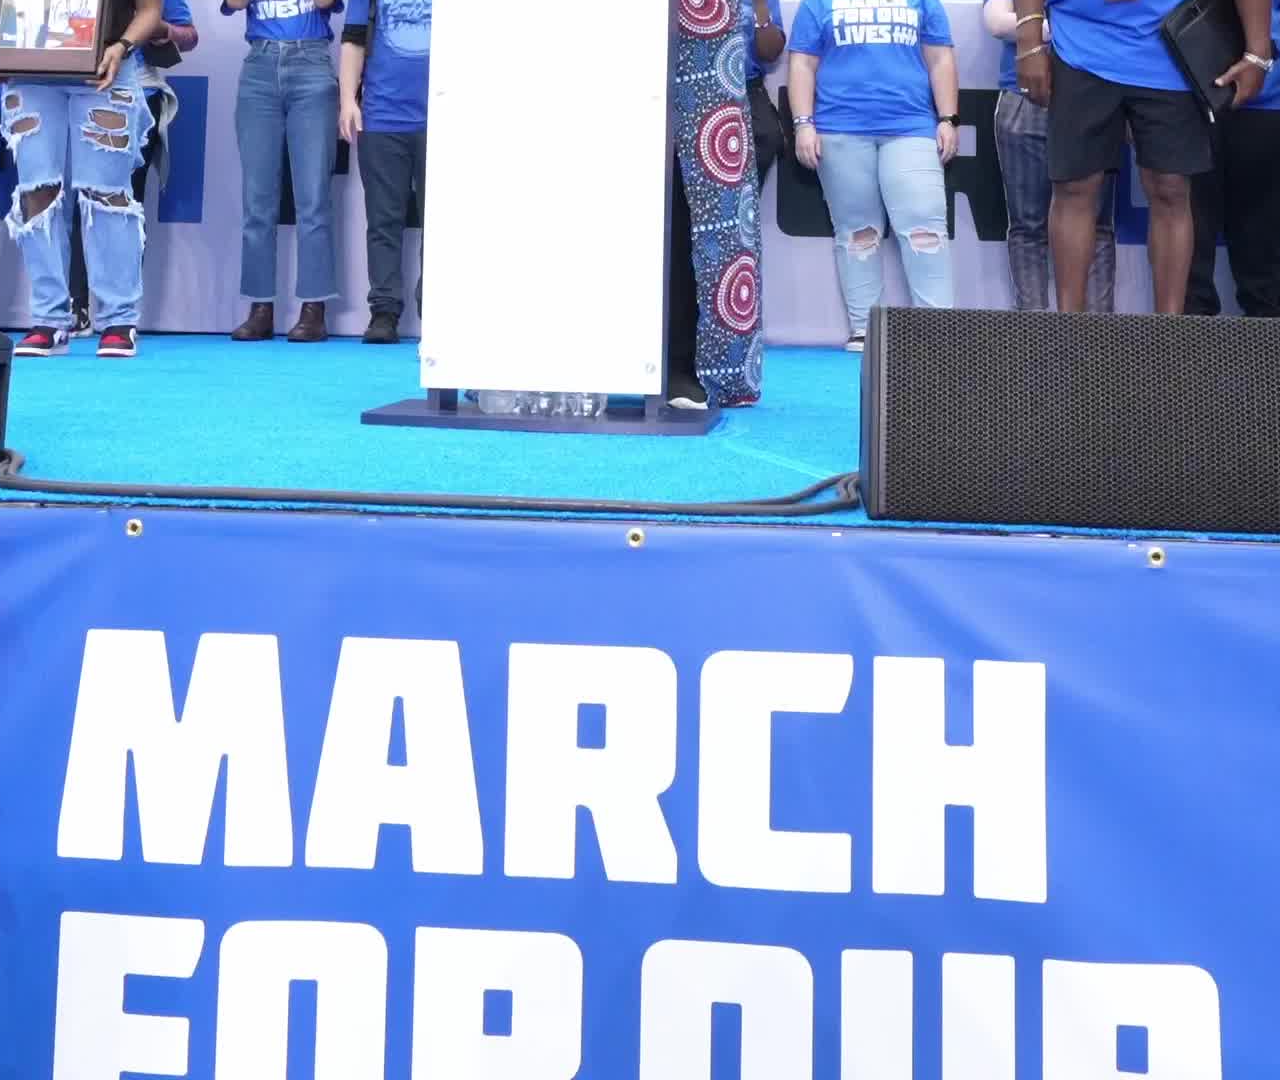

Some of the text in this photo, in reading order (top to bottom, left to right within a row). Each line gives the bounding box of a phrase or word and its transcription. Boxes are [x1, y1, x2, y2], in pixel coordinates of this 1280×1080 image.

[832, 7, 918, 29] FOR OUR
[833, 24, 891, 47] LIVES
[57, 628, 1047, 904] MARCH
[52, 910, 584, 1080] FOR
